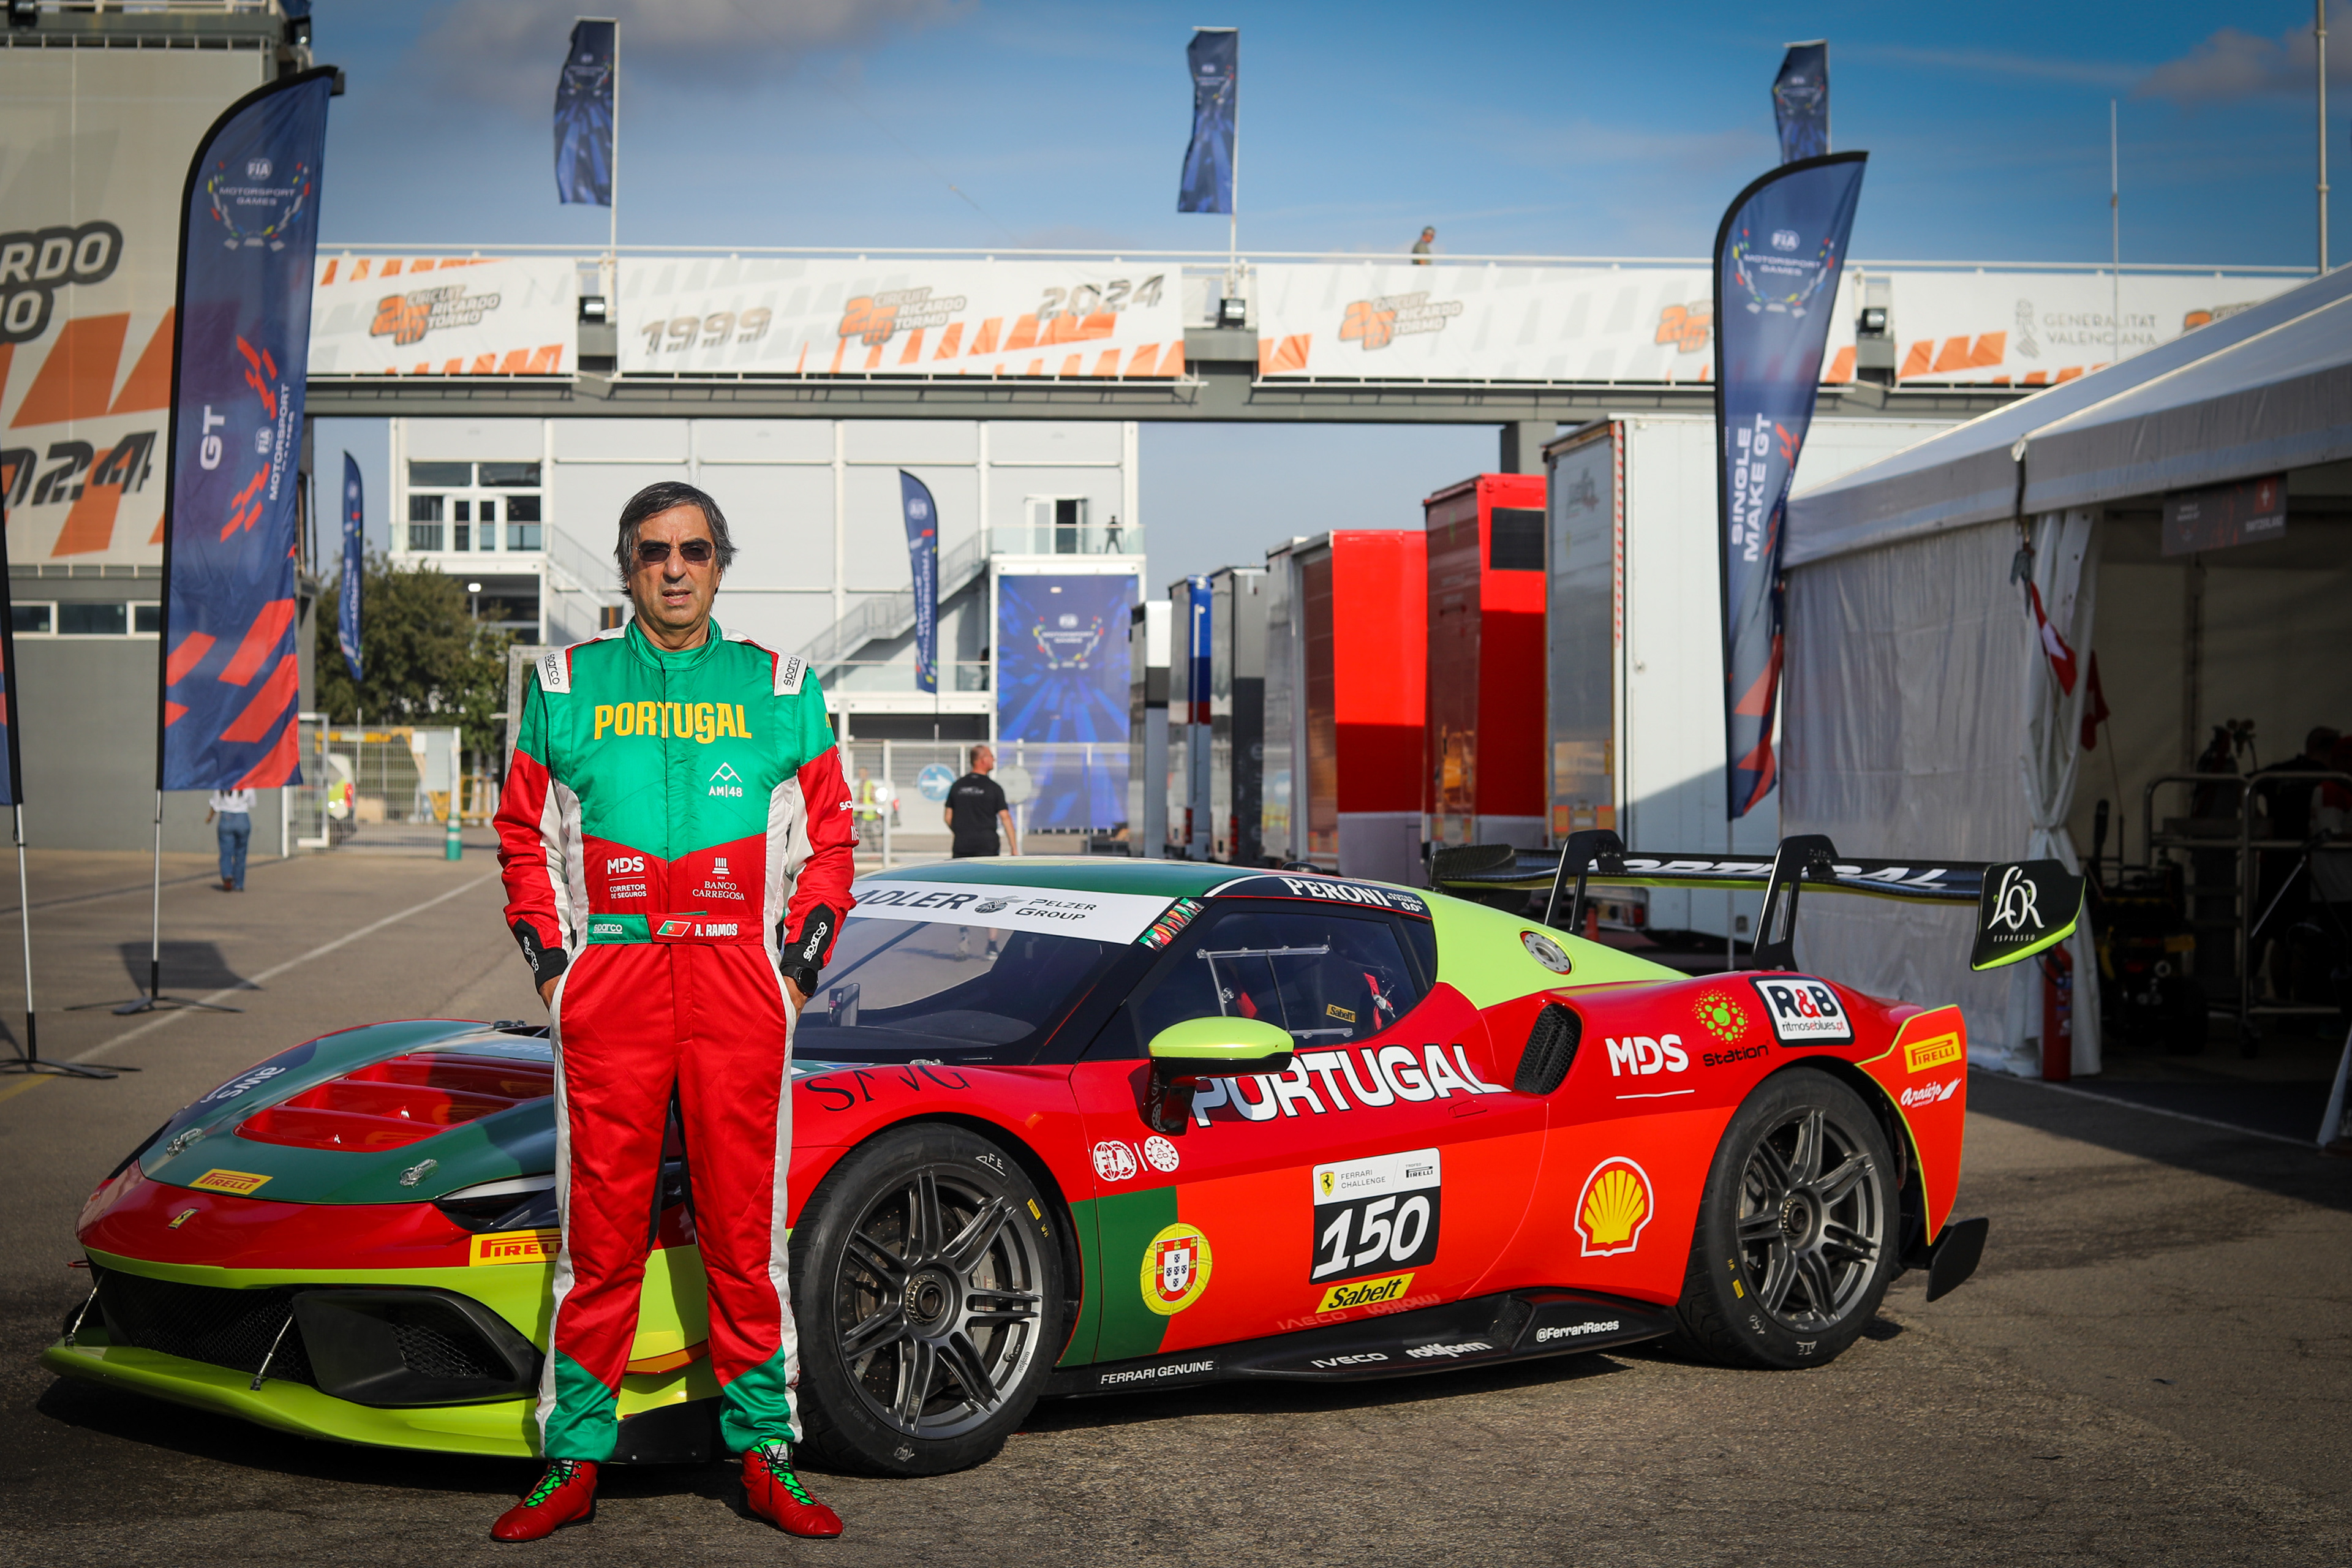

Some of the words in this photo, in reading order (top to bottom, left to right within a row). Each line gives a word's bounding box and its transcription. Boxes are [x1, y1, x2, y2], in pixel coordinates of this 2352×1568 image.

[219, 187, 295, 196] MOTORSPORT
[236, 197, 277, 206] GAMES
[1743, 254, 1822, 268] MOTORSPORT
[1760, 265, 1803, 276] GAMES
[1035, 273, 1165, 321] 2024
[641, 306, 772, 356] 1999
[200, 404, 225, 470] GT
[269, 383, 290, 500] MOTORSPORT
[1752, 412, 1772, 457] GT
[1731, 428, 1752, 546] SINGLE
[1743, 462, 1767, 562] MAKE
[544, 654, 560, 685] sparco
[783, 657, 801, 687] sparco
[594, 701, 752, 744] PORTUGAL
[607, 856, 644, 875] MDS
[609, 884, 646, 893] CORRETOR
[692, 889, 745, 900] CARREGOSA
[704, 881, 737, 891] BANCO
[1279, 877, 1392, 907] PERONI
[1015, 908, 1086, 921] GROUP
[1028, 899, 1097, 911] PELZER
[593, 924, 623, 934] sparco
[695, 924, 704, 937] A.
[706, 923, 738, 937] RAMOS
[1993, 934, 2035, 943] ESPRESSO
[803, 922, 828, 962] sparco
[1330, 1005, 1354, 1019] Sabelt
[1767, 986, 1838, 1018] R&B
[1782, 1021, 1845, 1032] ritmoseblues.pt
[1605, 1035, 1689, 1076] MDS
[1703, 1045, 1768, 1067] Station
[1911, 1039, 1954, 1066] PIRELLI
[1191, 1044, 1512, 1127] PORTUGAL
[198, 1172, 261, 1190] PIRELLI
[1341, 1170, 1373, 1180] FERRARI
[1341, 1177, 1385, 1189] CHALLENGE
[1406, 1166, 1433, 1178] PIRELLI
[480, 1234, 562, 1258] PIREL
[1312, 1195, 1430, 1280] 150
[1328, 1278, 1402, 1309] Sabelt
[1536, 1320, 1619, 1342] @FerrariRaces
[1311, 1352, 1388, 1368] IVECO
[1406, 1341, 1493, 1359] rotiform
[1101, 1366, 1155, 1384] FERRARI
[1158, 1360, 1213, 1378] GENUINE
